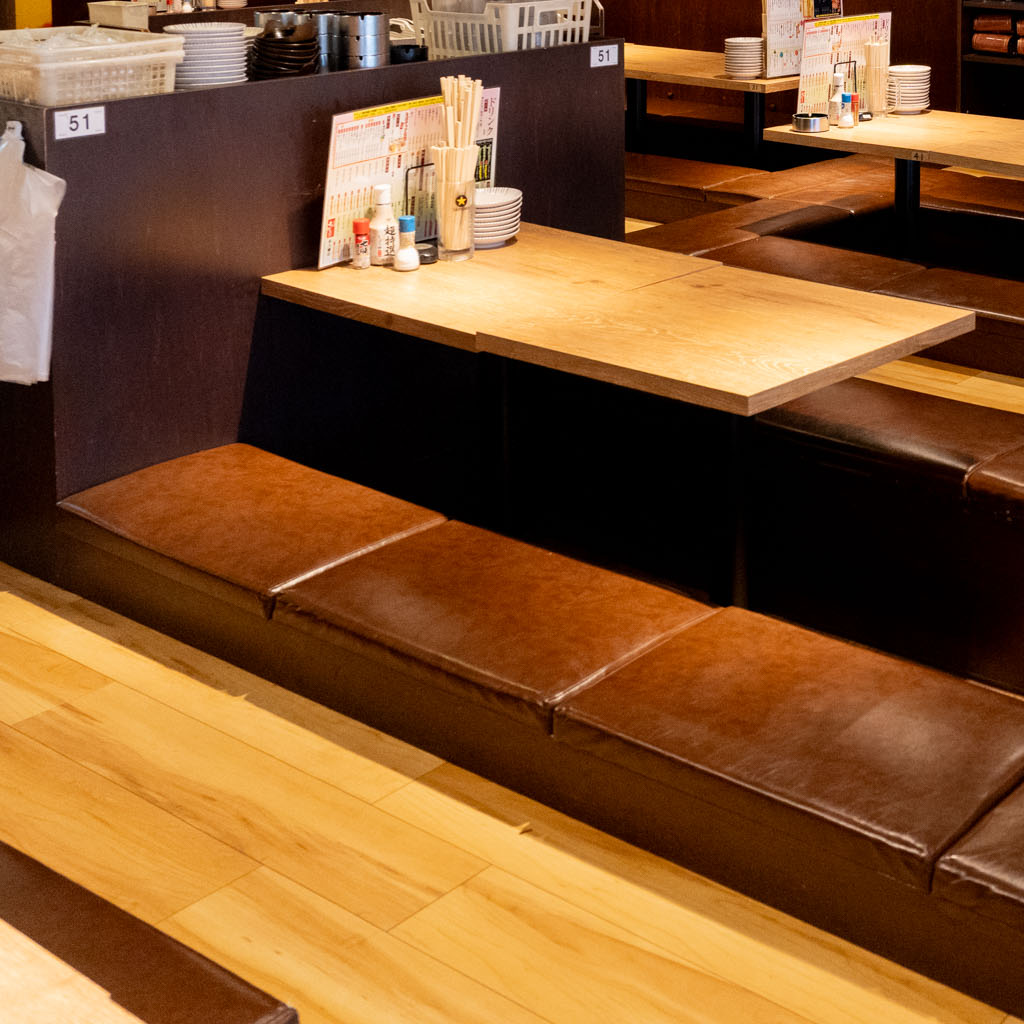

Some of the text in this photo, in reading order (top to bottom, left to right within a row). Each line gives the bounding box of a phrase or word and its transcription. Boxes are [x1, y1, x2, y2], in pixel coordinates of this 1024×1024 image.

[598, 49, 610, 63] 51
[69, 114, 90, 132] 51
[487, 97, 497, 136] ドリンク
[913, 152, 924, 161] 41
